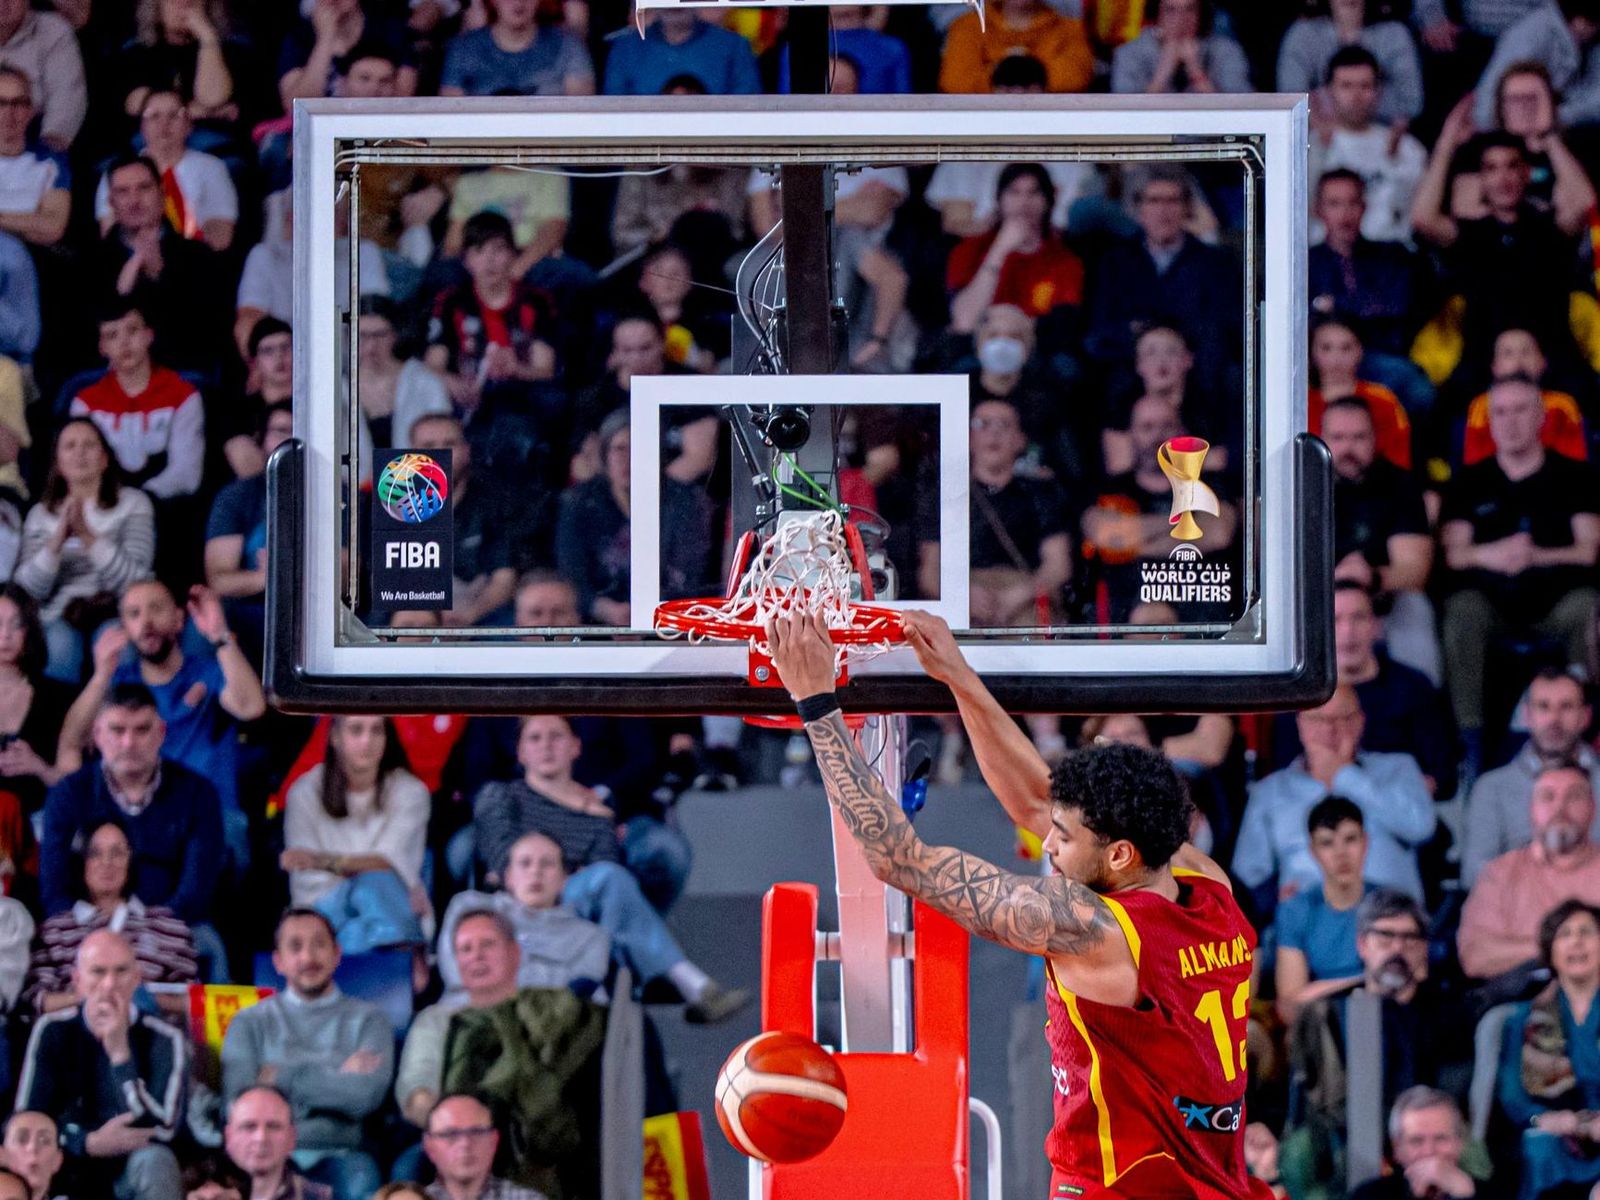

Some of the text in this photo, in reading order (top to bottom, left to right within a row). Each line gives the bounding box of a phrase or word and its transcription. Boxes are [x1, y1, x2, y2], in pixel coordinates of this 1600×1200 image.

[385, 541, 440, 568] FIBA
[1176, 550, 1197, 561] FIBA
[1142, 562, 1231, 571] BASKETBALL
[1141, 570, 1232, 584] WORLD CUP
[381, 590, 446, 601] We Are Basketball
[1140, 584, 1232, 603] QUALIFIERS
